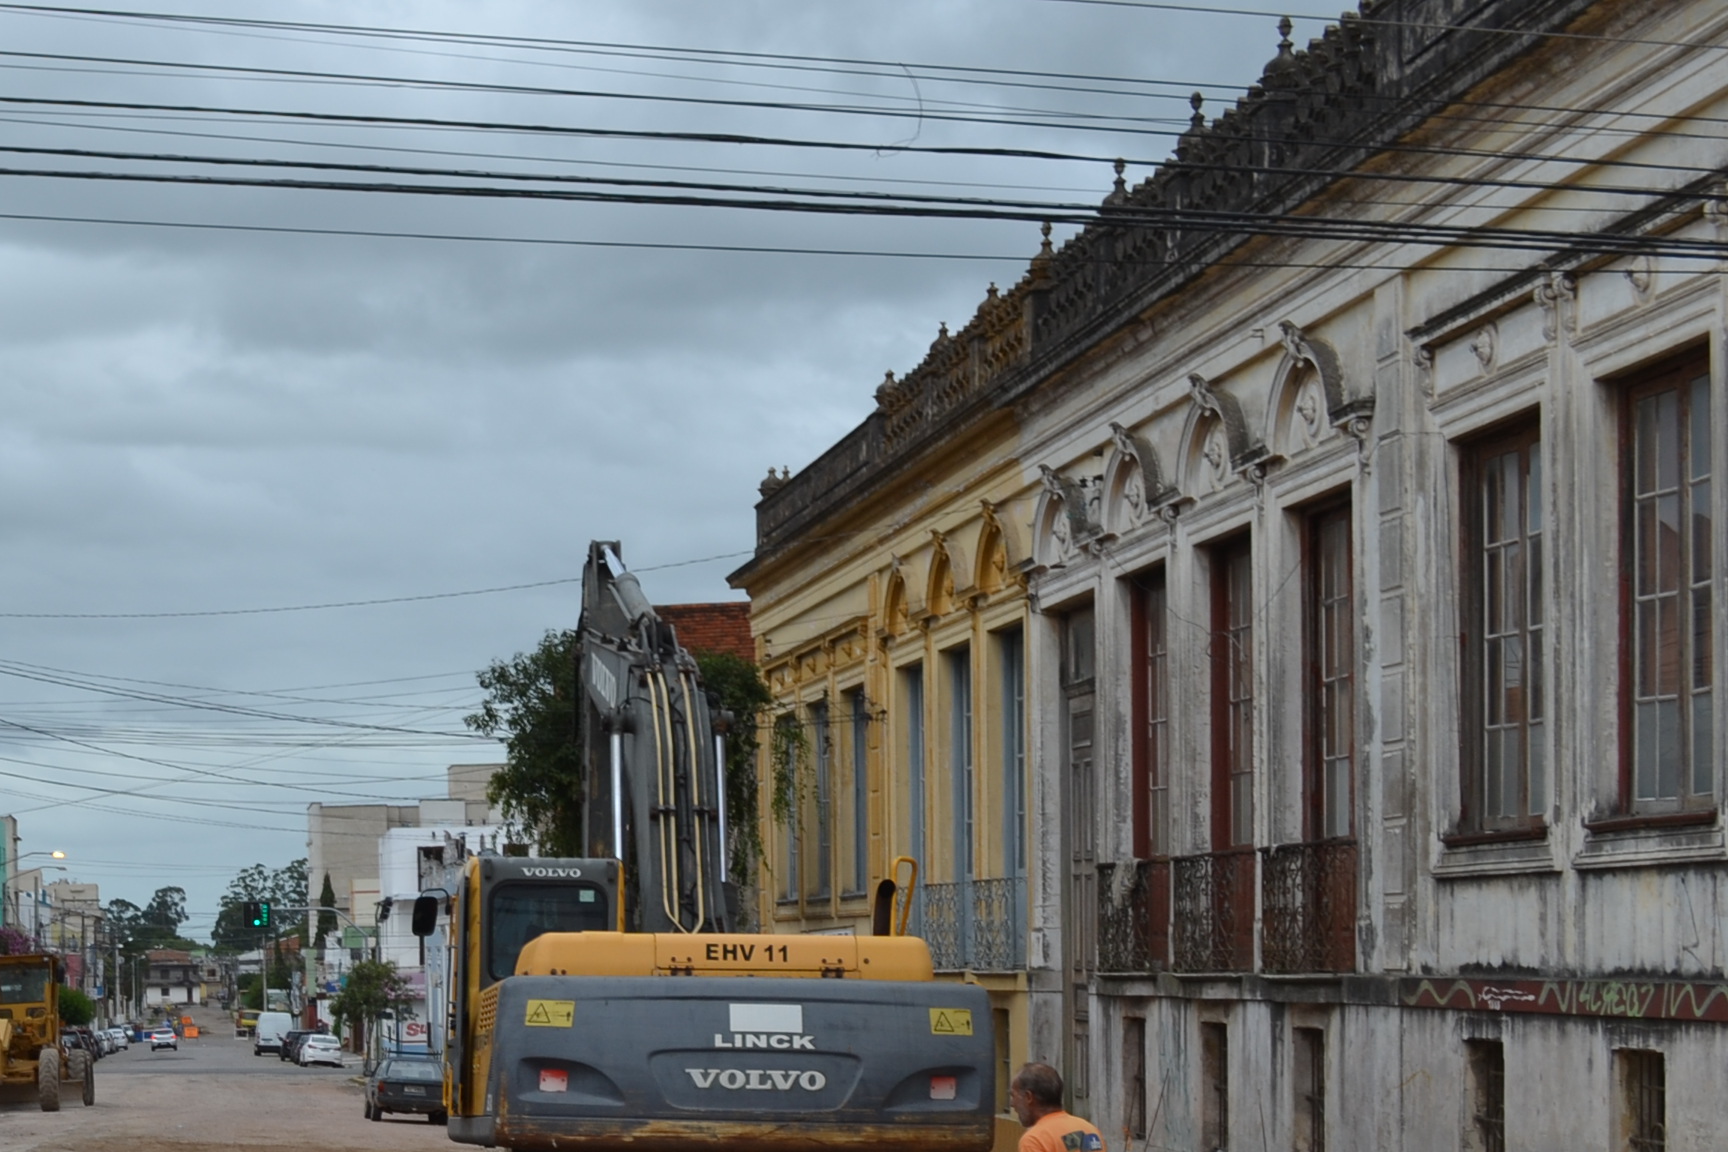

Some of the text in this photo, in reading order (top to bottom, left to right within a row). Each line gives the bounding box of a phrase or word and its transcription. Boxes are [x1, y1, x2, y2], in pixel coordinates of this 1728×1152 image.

[591, 652, 617, 708] VOLVO
[520, 867, 582, 879] VOLVO
[705, 943, 788, 963] EHV 11
[714, 1033, 816, 1050] LINCK
[684, 1067, 827, 1092] VOLVO
